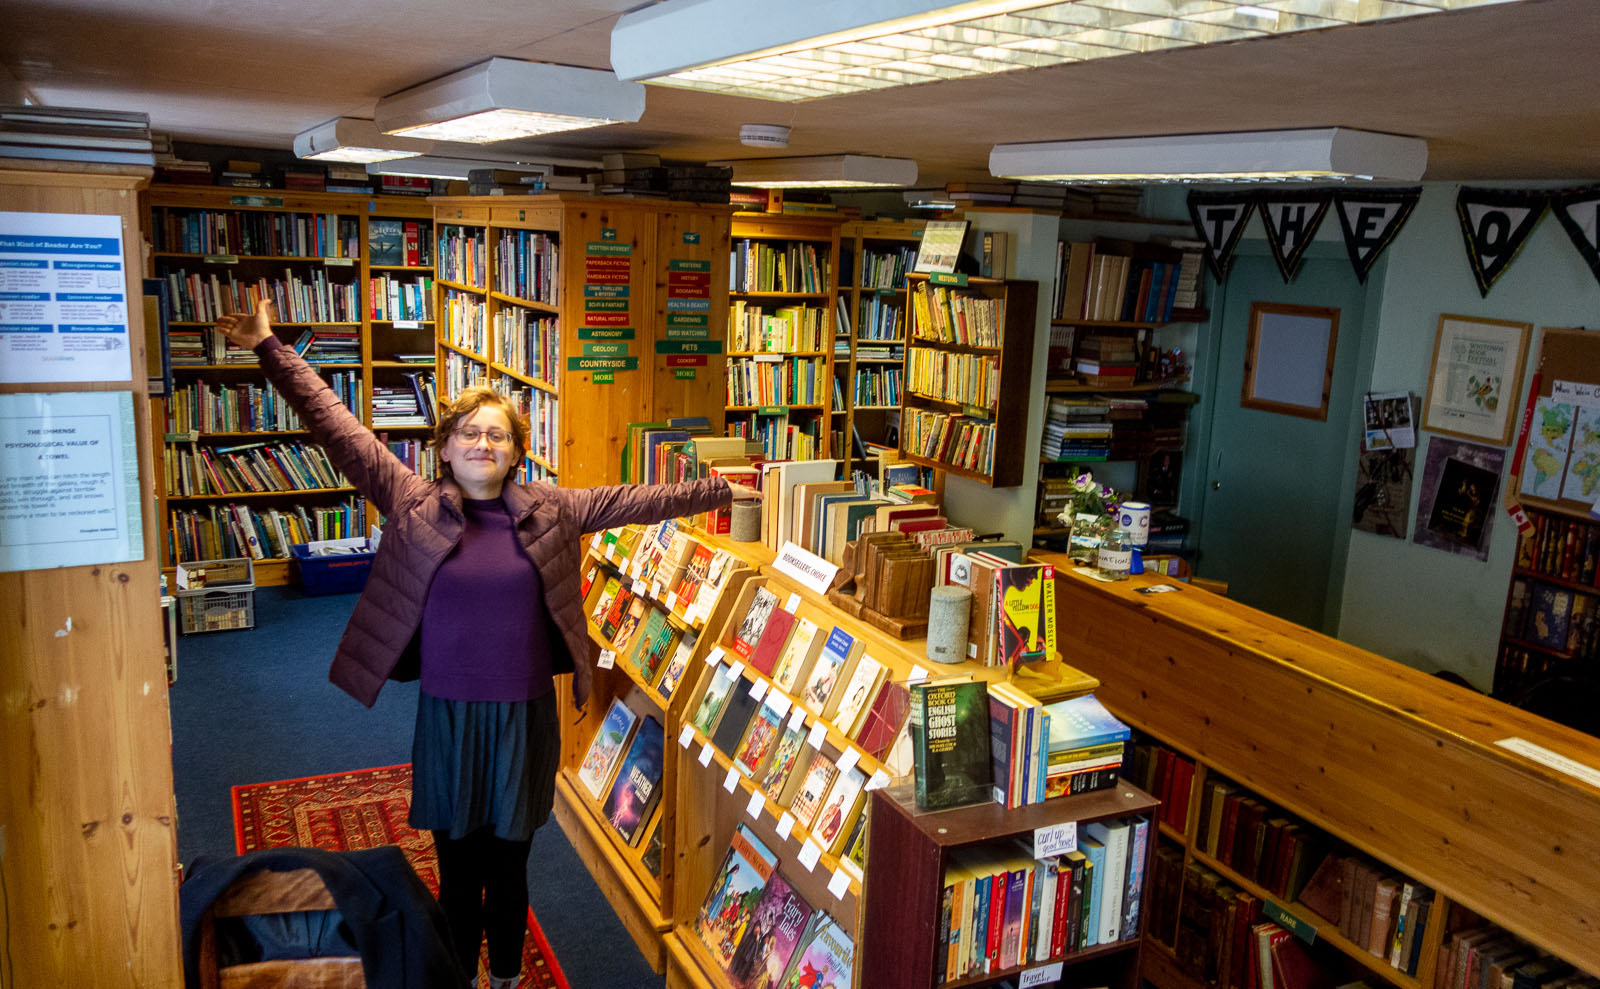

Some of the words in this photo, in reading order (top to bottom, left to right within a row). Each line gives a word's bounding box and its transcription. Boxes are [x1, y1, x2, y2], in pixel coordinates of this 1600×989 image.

[1207, 206, 1385, 251] THE
[681, 343, 698, 351] PETS
[579, 360, 627, 368] COUNTRYSIDE
[5, 441, 64, 449] PSYCHOLOGICAL
[782, 553, 811, 574] BOOKSELLERS
[810, 568, 827, 582] CHOICE
[1045, 582, 1053, 613] WALTER
[1012, 603, 1030, 612] YELLOW
[1046, 617, 1055, 648] MOSLEY
[928, 691, 956, 700] OXFORD
[928, 704, 957, 717] ENGLISH
[928, 715, 957, 729] GHOST
[928, 726, 957, 739] STORIES
[630, 764, 653, 796] WEATHER
[784, 895, 805, 928] Fairy
[1280, 912, 1297, 929] RARE
[778, 915, 797, 942] Tales
